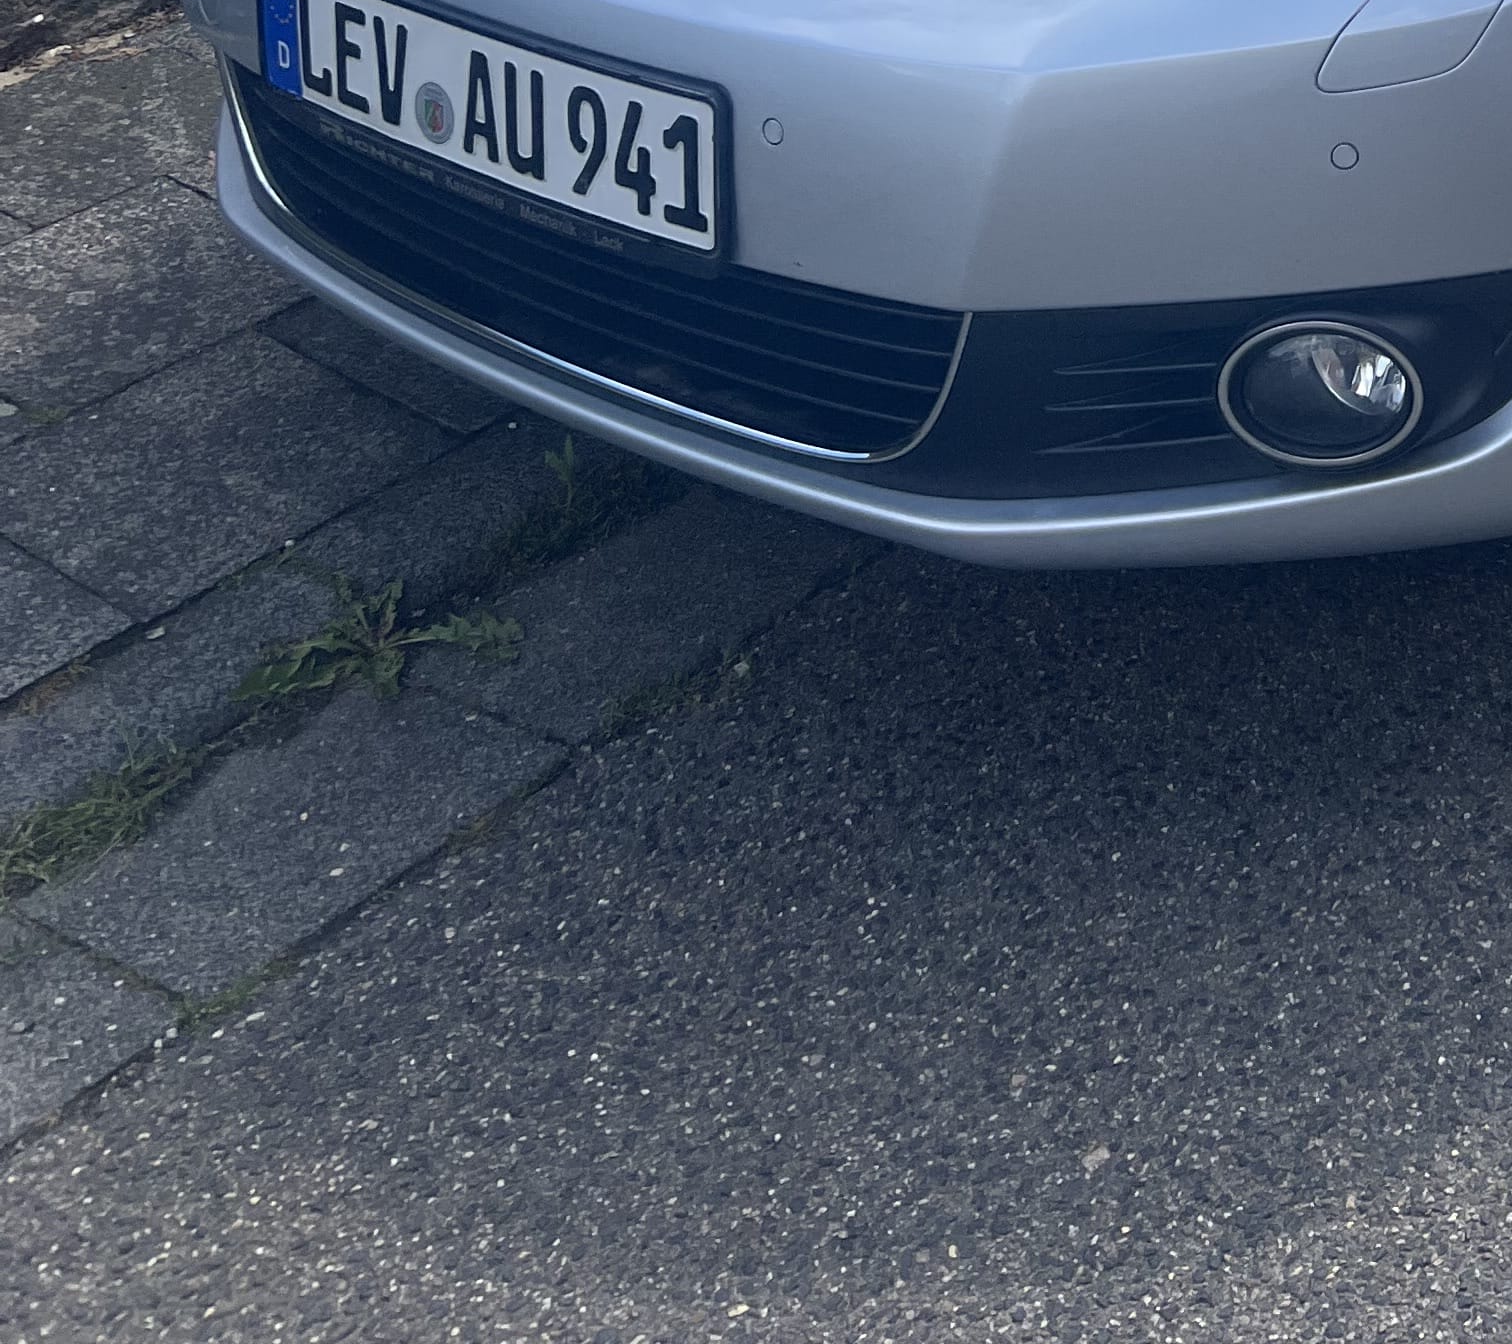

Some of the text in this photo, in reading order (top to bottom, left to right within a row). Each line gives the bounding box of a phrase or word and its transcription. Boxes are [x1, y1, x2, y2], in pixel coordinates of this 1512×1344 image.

[277, 39, 290, 70] D
[463, 49, 545, 181] AU
[567, 85, 708, 233] 941
